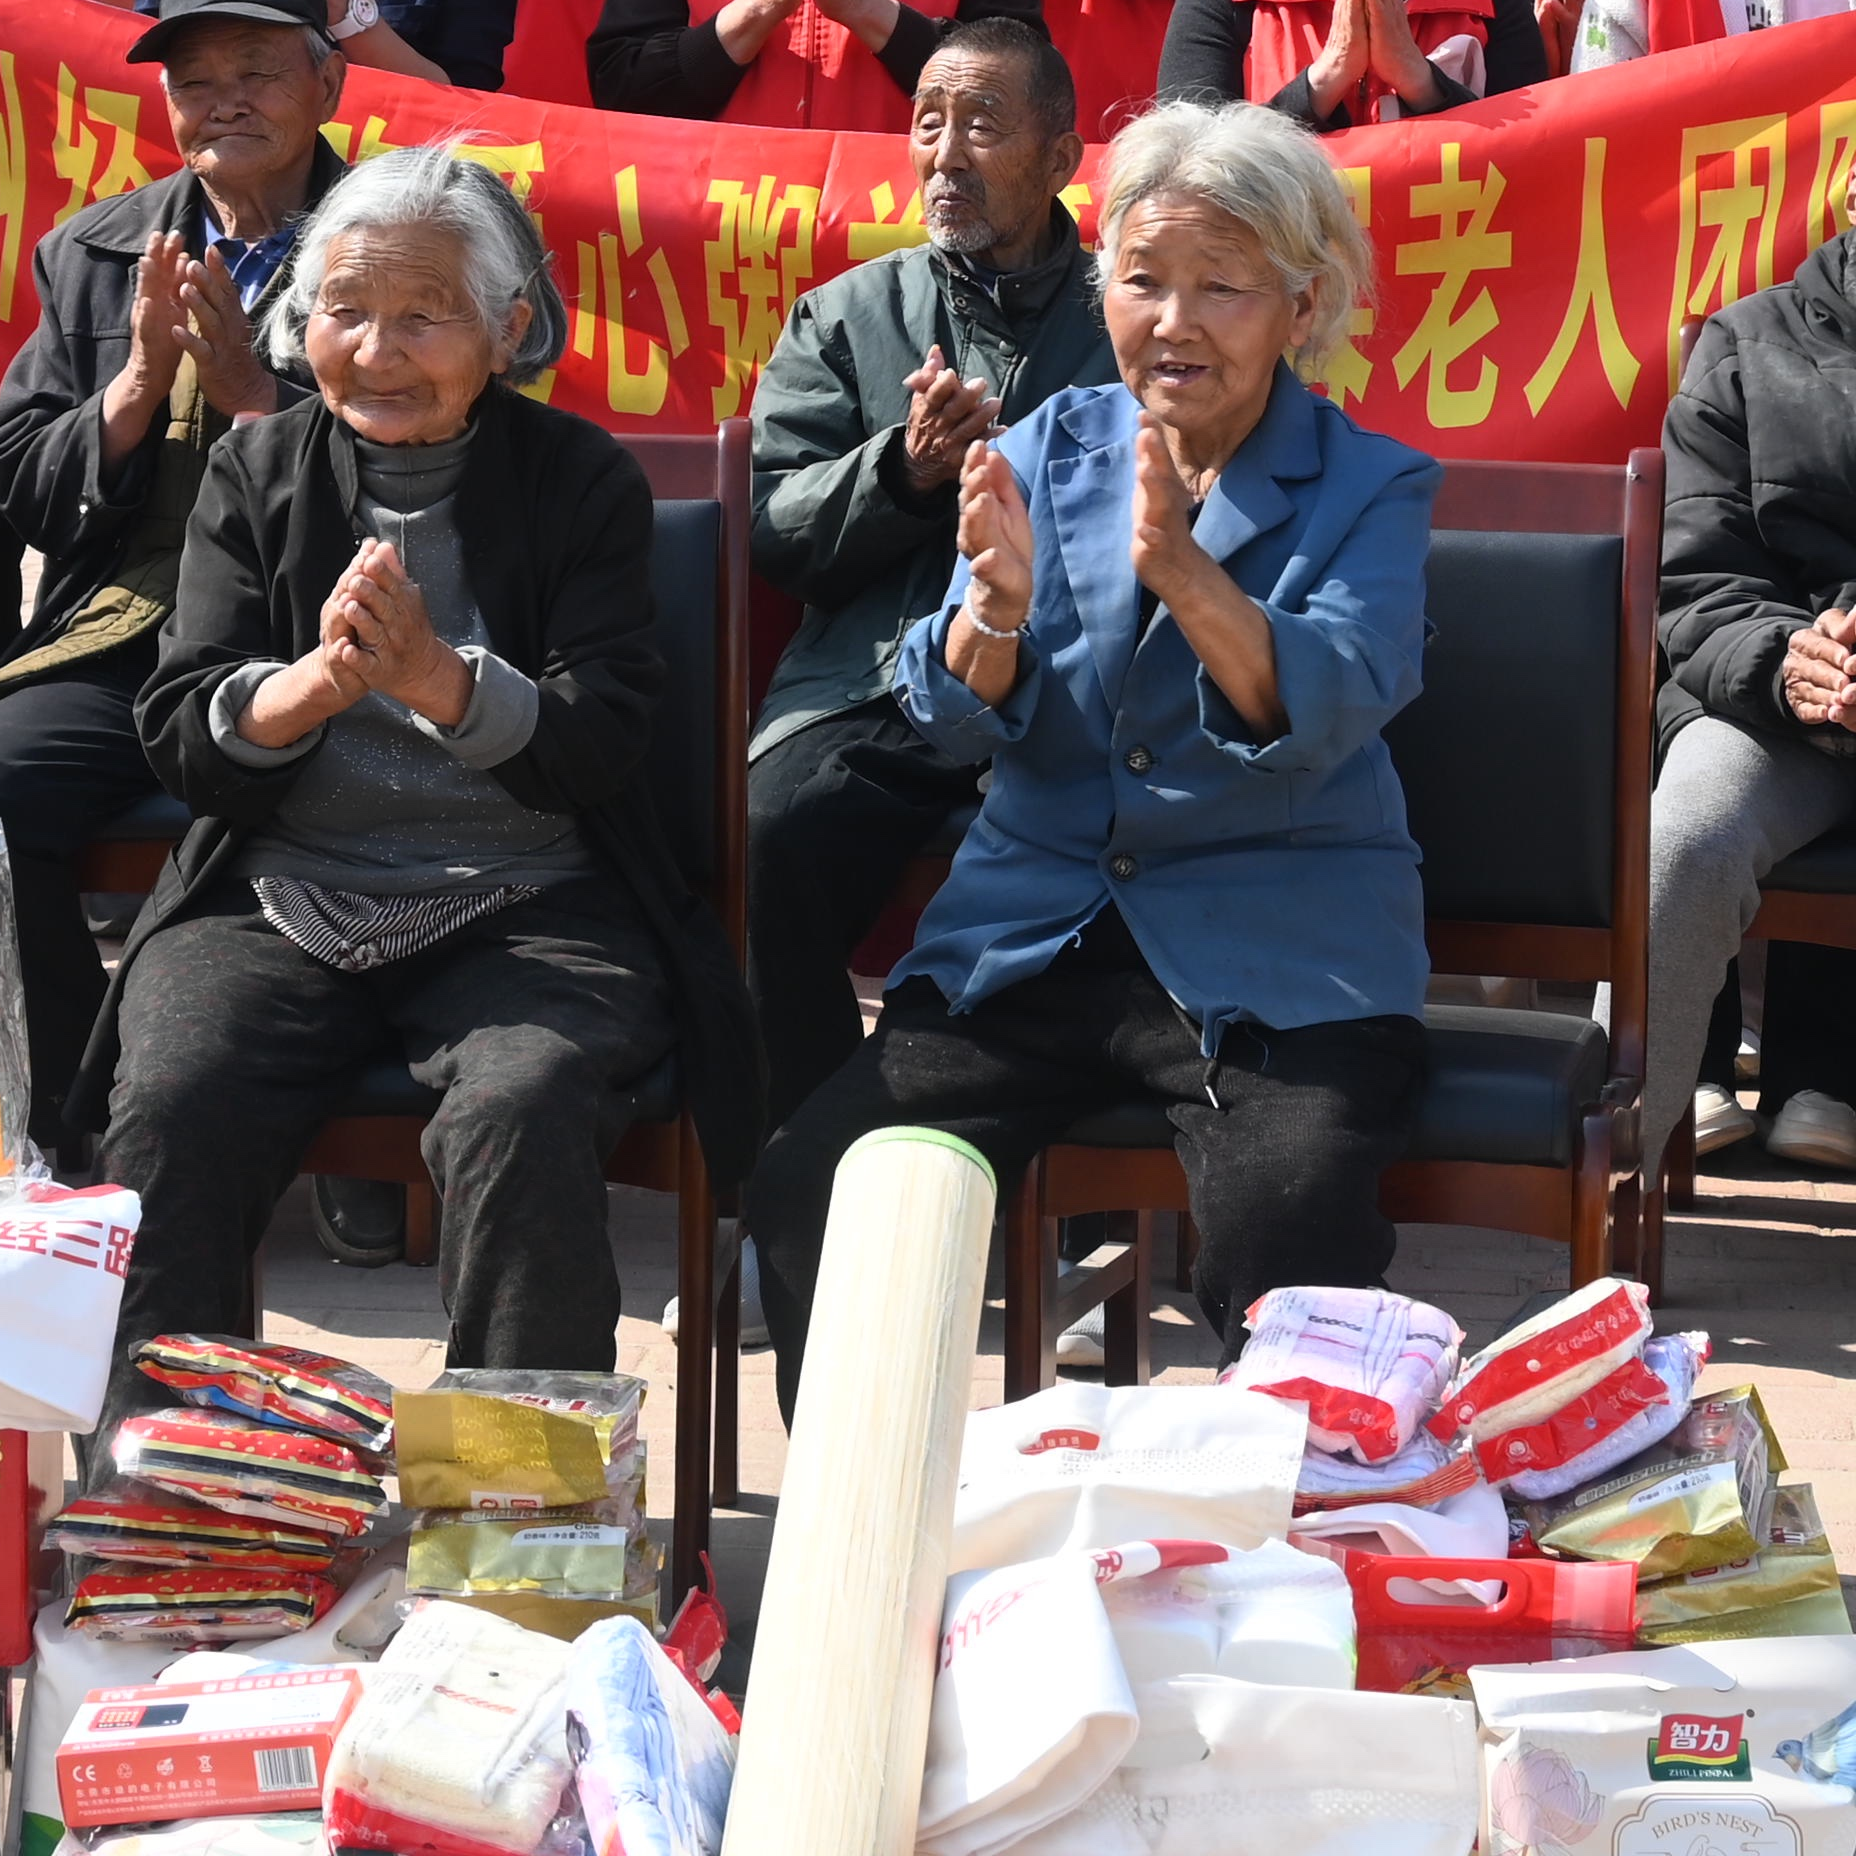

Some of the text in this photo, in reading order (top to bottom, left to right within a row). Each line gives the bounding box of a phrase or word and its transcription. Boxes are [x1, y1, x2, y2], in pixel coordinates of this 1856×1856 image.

[1670, 1721, 1731, 1753] 智力
[1668, 1768, 1698, 1779] ZHILI
[1714, 1811, 1764, 1838] NEST
